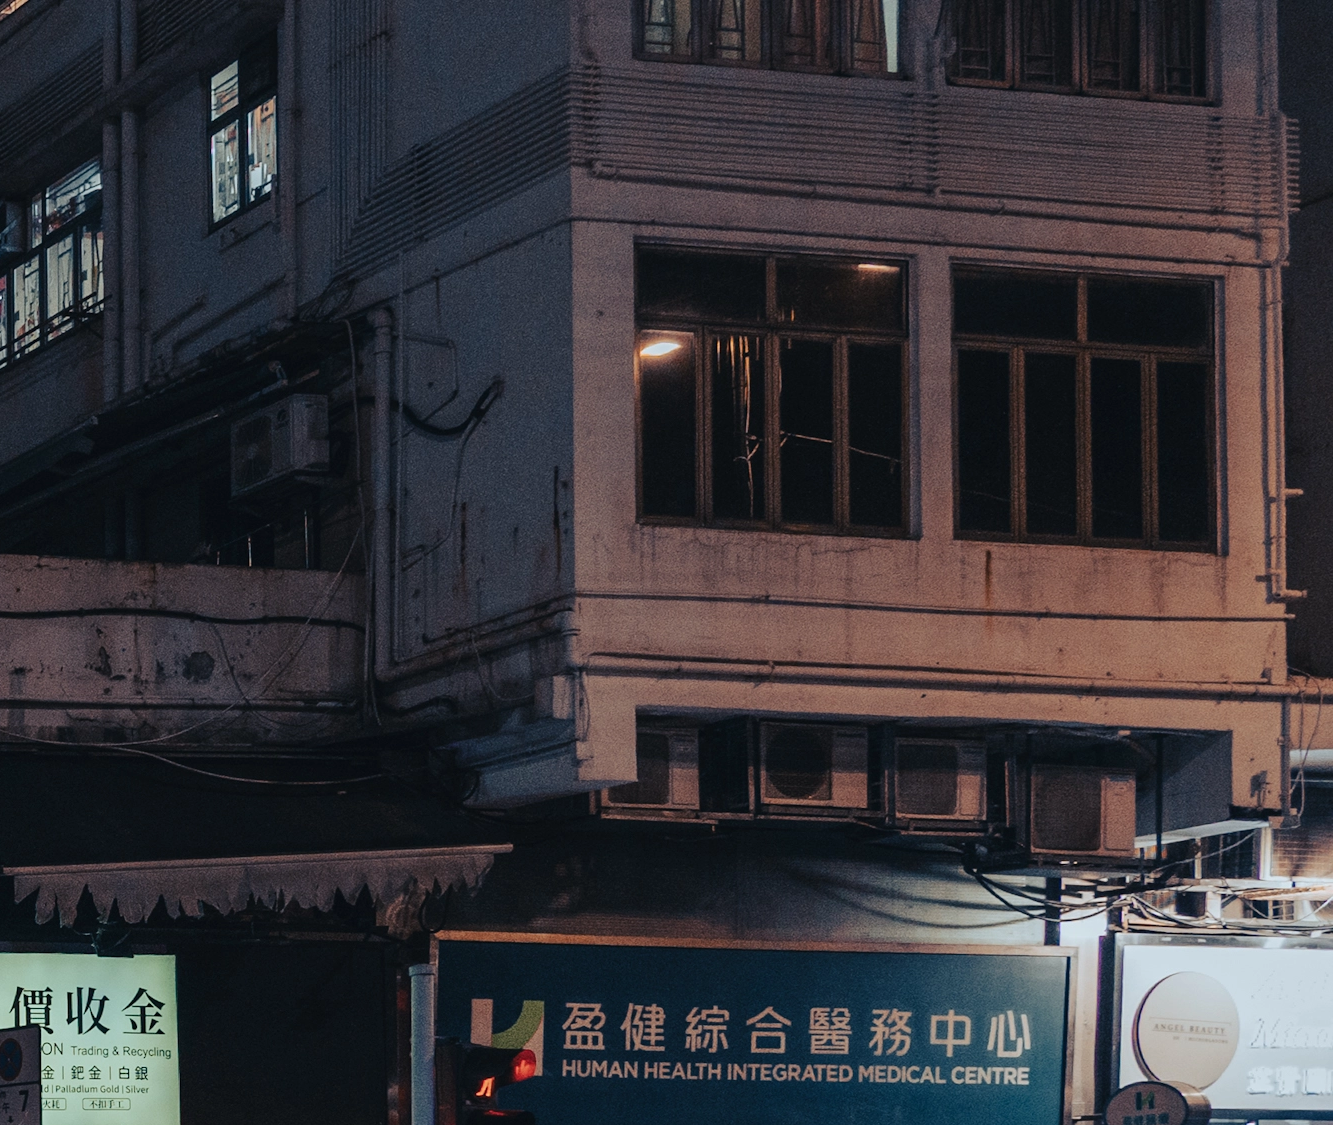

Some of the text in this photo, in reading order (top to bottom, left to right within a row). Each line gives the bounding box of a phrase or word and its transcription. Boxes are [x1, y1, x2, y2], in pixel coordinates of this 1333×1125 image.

[562, 1002, 1031, 1058] 盈健綜合醫務中心
[1154, 1024, 1226, 1034] ANGEL BEAUTY
[71, 1045, 109, 1058] Trading
[112, 1046, 119, 1056] &
[123, 1046, 172, 1060] Recycling
[118, 1066, 149, 1081] 白銀
[562, 1060, 1030, 1085] HUMAN HEALTH INTEGRATED MEDICAL CENTRE
[100, 1084, 120, 1093] Gold
[125, 1085, 149, 1094] Silver
[19, 1089, 29, 1112] 7
